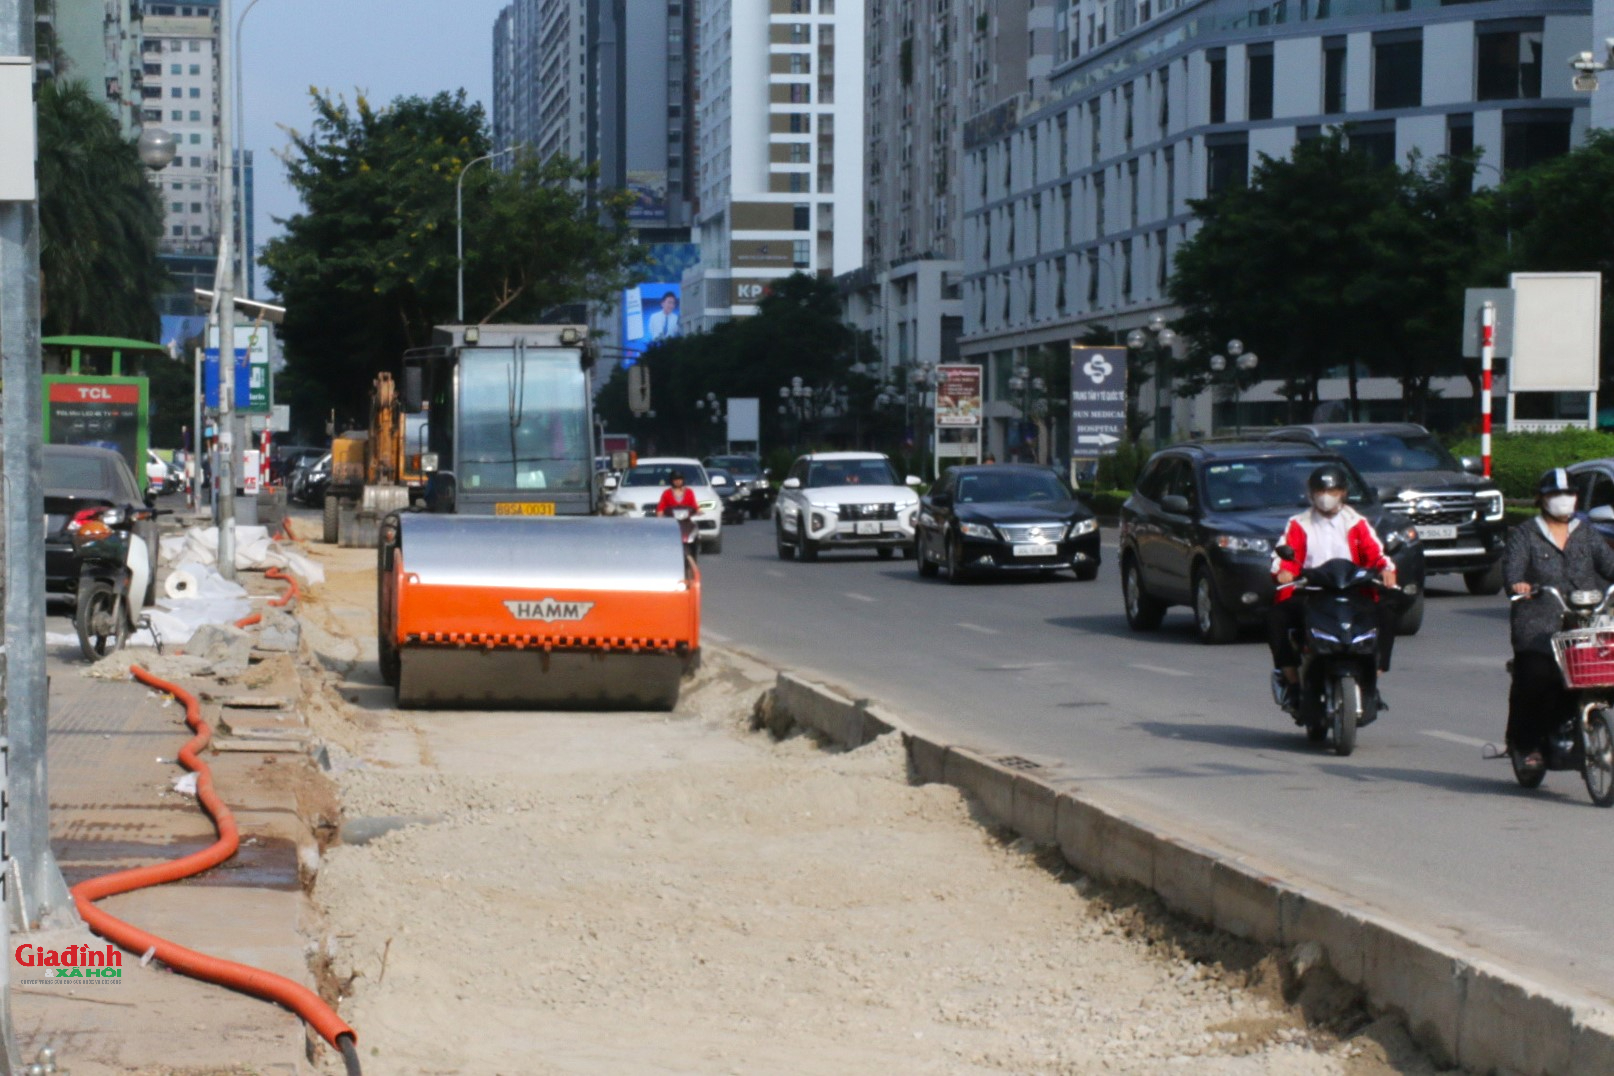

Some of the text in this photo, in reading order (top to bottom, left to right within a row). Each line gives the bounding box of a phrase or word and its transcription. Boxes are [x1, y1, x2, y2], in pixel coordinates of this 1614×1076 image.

[78, 387, 112, 399] TCL
[1072, 410, 1126, 418] SUN MEDICAL
[1077, 424, 1119, 433] HOSPITAL
[518, 603, 579, 618] HAMM
